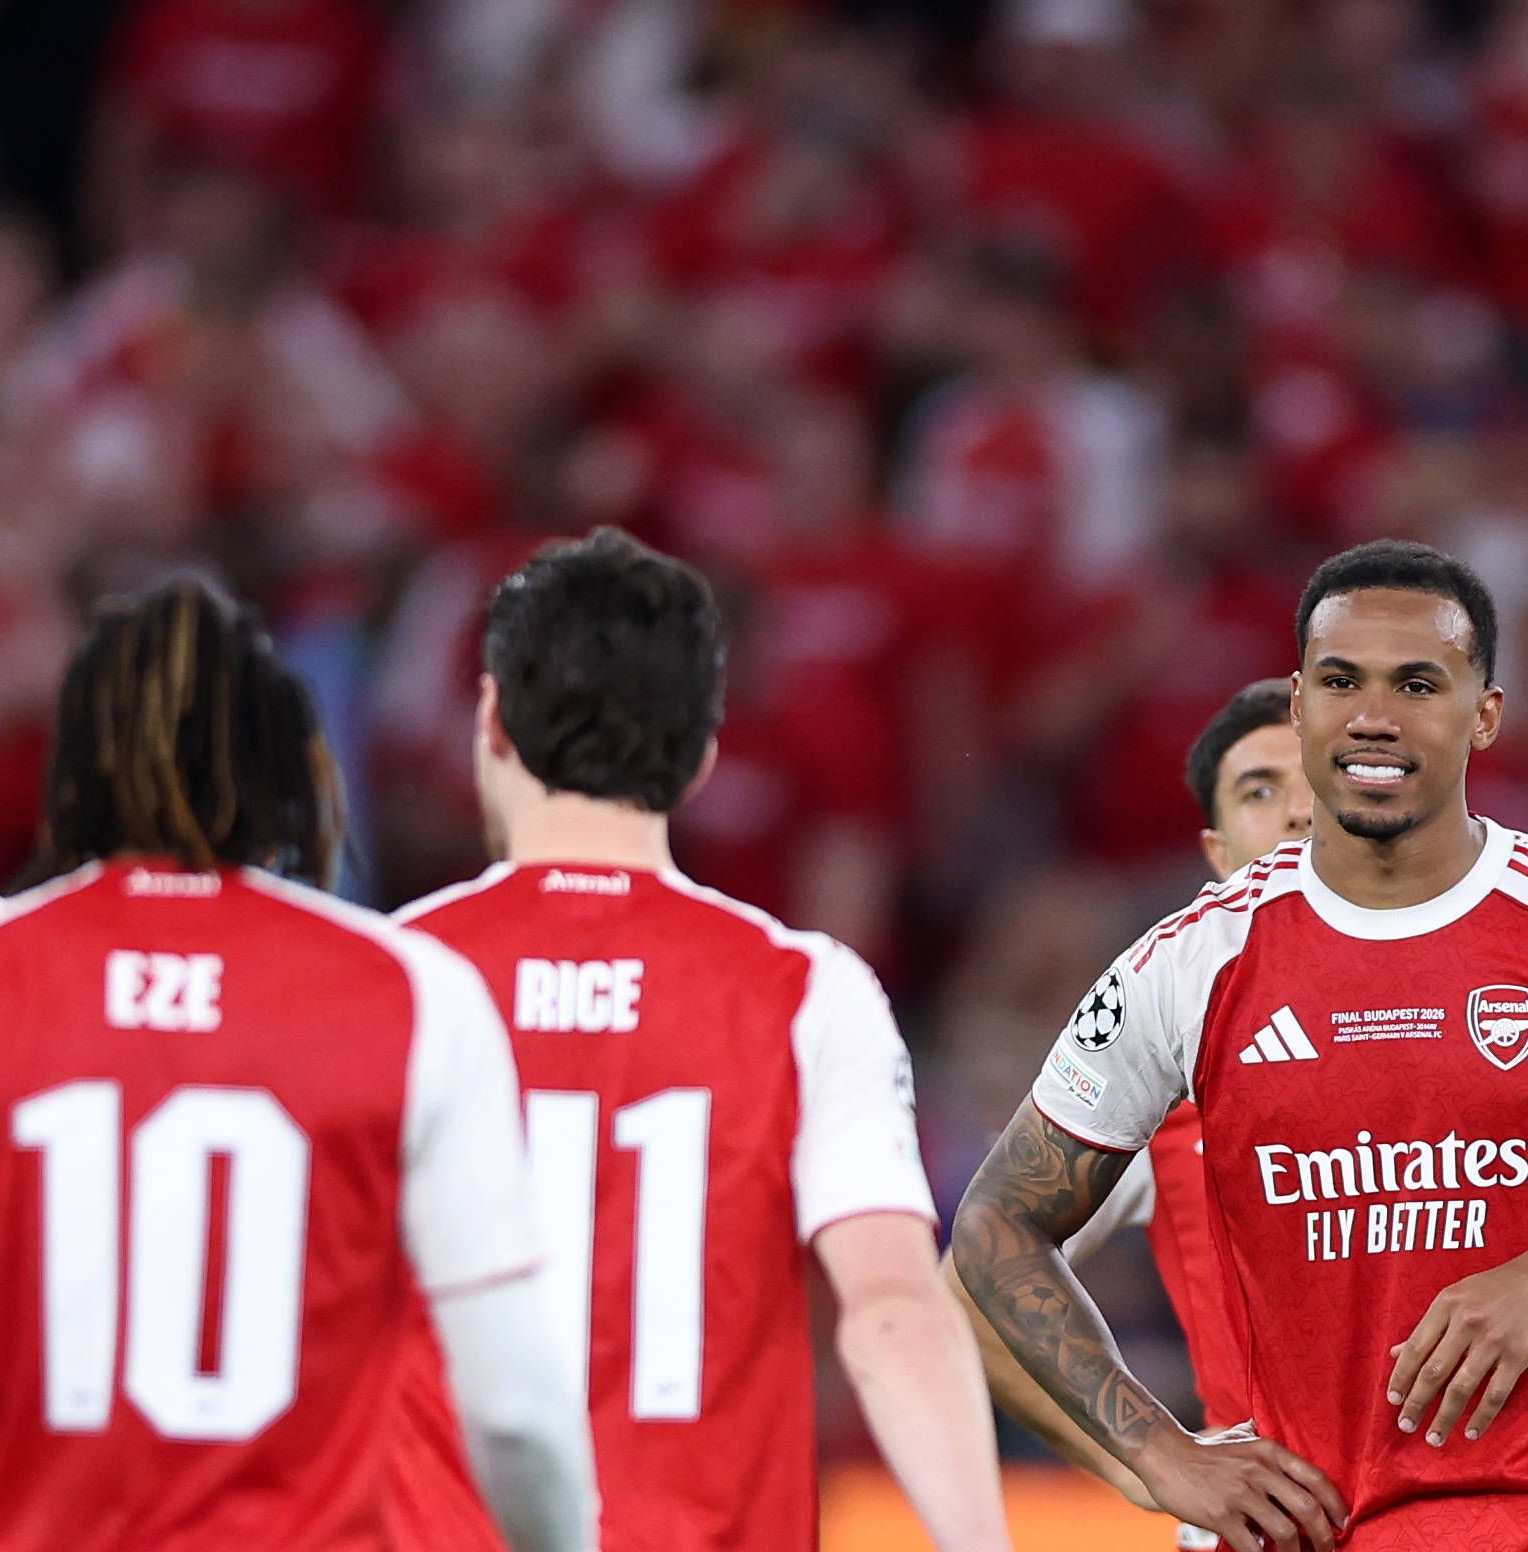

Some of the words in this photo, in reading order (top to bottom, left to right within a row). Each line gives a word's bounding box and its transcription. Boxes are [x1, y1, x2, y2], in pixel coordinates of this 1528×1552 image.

[104, 949, 224, 1032] EZE
[514, 957, 644, 1033] RICE
[1331, 1011, 1362, 1024] FINAL
[1364, 1008, 1419, 1022] BUDAPEST
[1420, 1008, 1445, 1020] 2026
[9, 1078, 313, 1444] 10
[1306, 1209, 1355, 1262] FLY
[1367, 1199, 1487, 1254] BETTER
